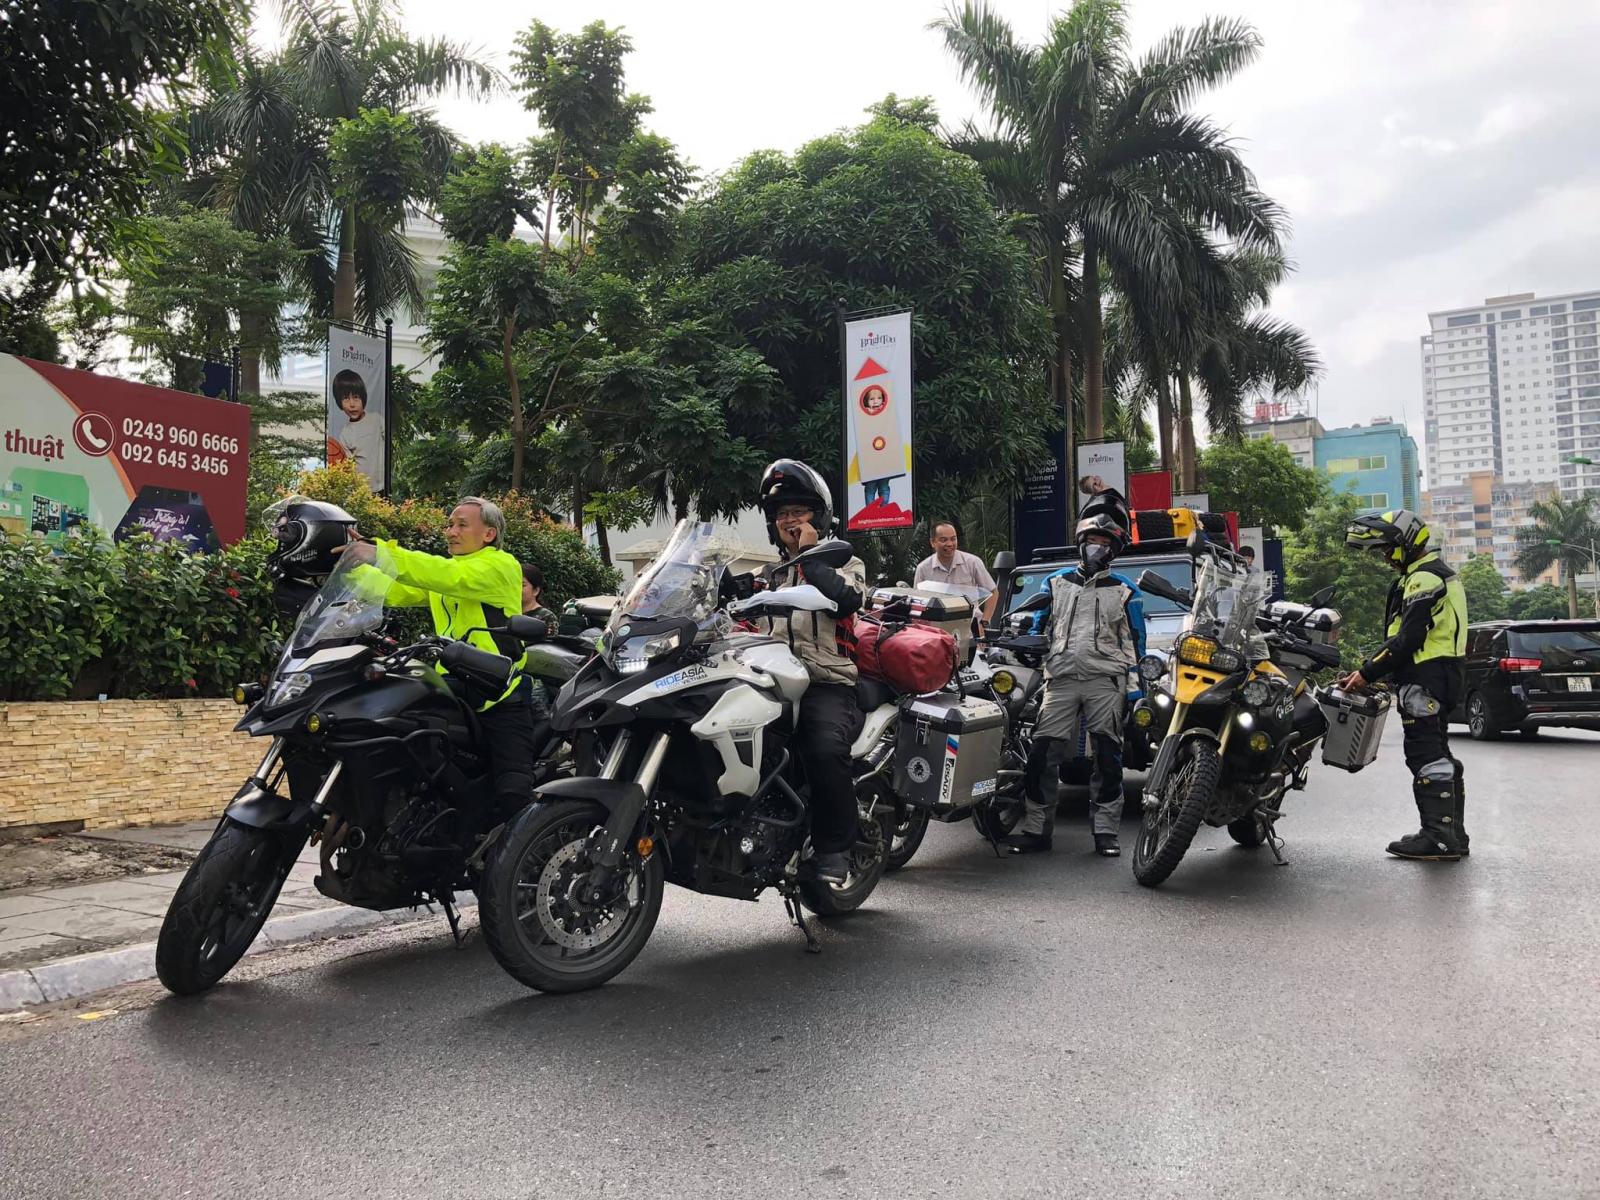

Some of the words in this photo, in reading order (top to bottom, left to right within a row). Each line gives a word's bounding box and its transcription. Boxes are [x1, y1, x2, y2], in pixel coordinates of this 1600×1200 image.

[4, 428, 65, 462] thuật
[122, 417, 164, 442] 0243
[168, 426, 198, 448] 960
[201, 432, 239, 455] 6666
[121, 441, 153, 464] 092
[157, 448, 187, 469] 645
[191, 454, 229, 476] 3456
